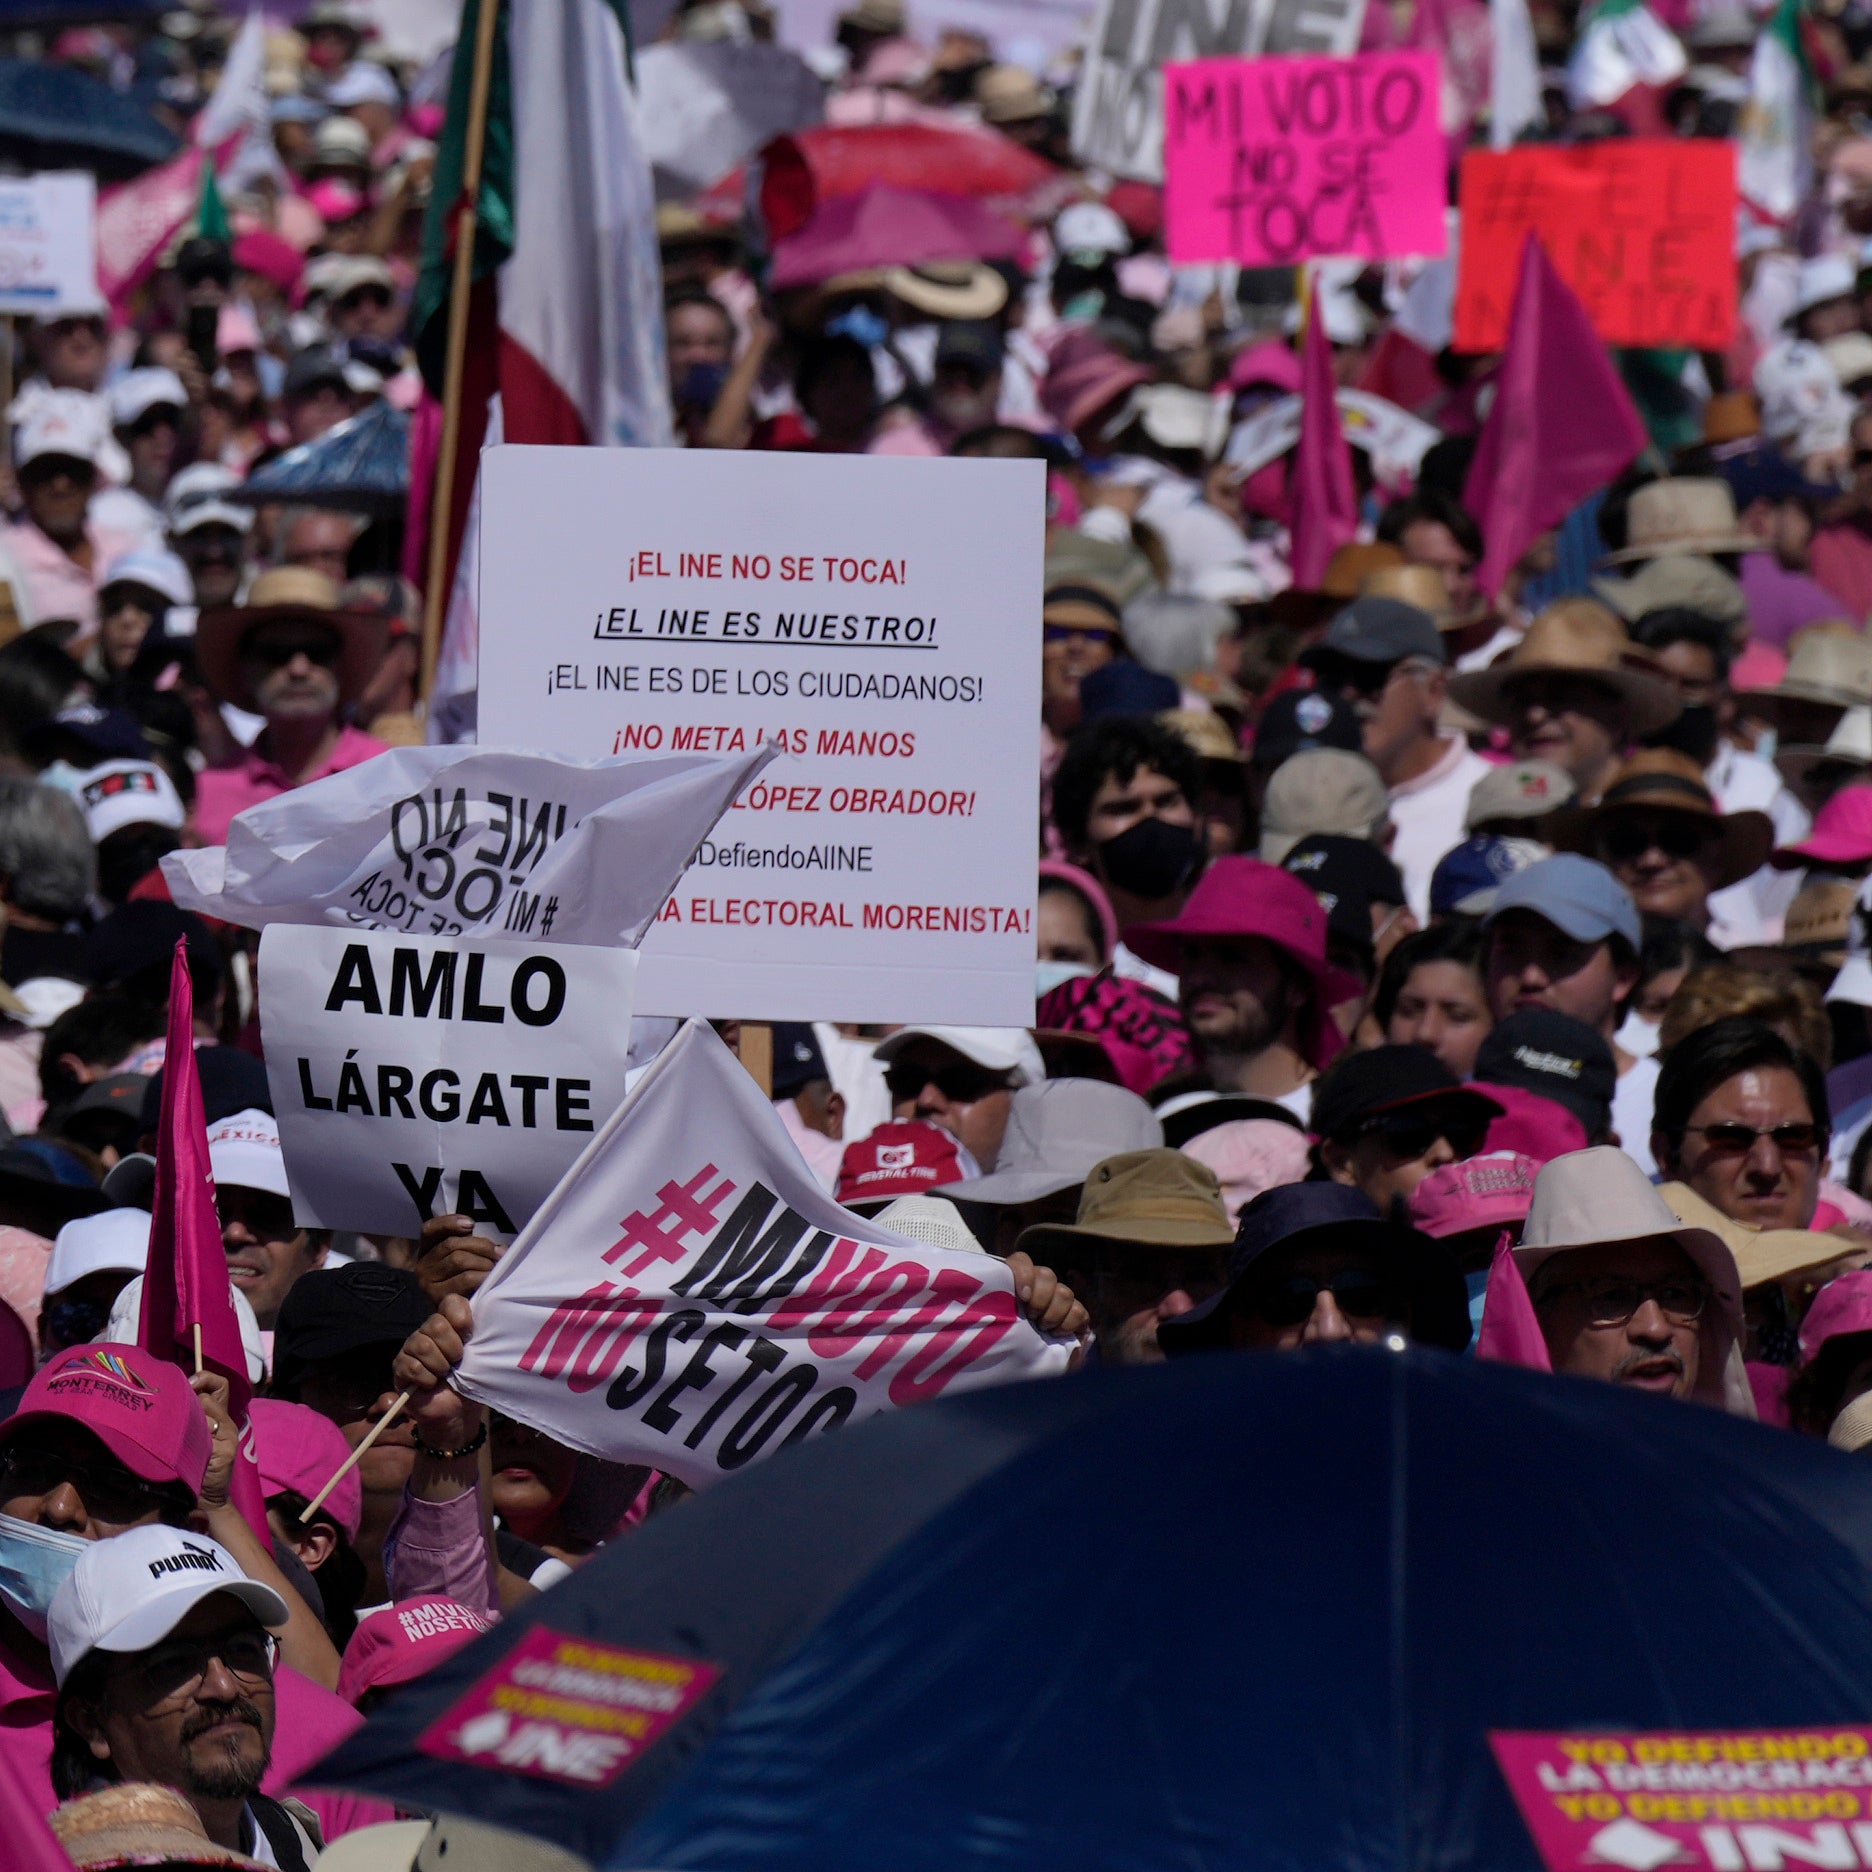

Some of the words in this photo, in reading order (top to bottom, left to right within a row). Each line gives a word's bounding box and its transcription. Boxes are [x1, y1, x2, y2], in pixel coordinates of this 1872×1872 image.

[1262, 68, 1421, 137] VOTO
[1213, 183, 1390, 263] TOCA
[628, 551, 671, 583] ¡EL
[679, 553, 722, 580] INE
[731, 555, 771, 581] NO
[780, 556, 815, 582] SE
[822, 558, 907, 585] TOCA!
[594, 608, 644, 640] ¡EL
[657, 610, 710, 636] INE
[722, 612, 761, 638] ES
[775, 613, 939, 644] NUESTRO!
[547, 664, 587, 697] ¡EL
[596, 666, 640, 692] INE
[649, 667, 683, 693] ES
[692, 668, 728, 694] DE
[738, 669, 789, 696] LOS
[798, 671, 984, 703] CIUDADANOS!
[613, 723, 662, 755] ¡NO
[671, 725, 745, 752] META
[816, 730, 916, 757] MANOS
[730, 779, 821, 812] LÓPEZ
[830, 788, 976, 817] OBRADOR!
[690, 897, 854, 927] ELECTORAL
[863, 903, 1032, 934] MORENISTA!
[324, 943, 567, 1028] AMLO
[297, 1048, 596, 1133] LÁRGATE
[390, 1162, 520, 1236] YA
[600, 1162, 1019, 1408] #MIVOTO
[46, 1377, 155, 1413] MONTERREY
[148, 1552, 221, 1580] PUMA
